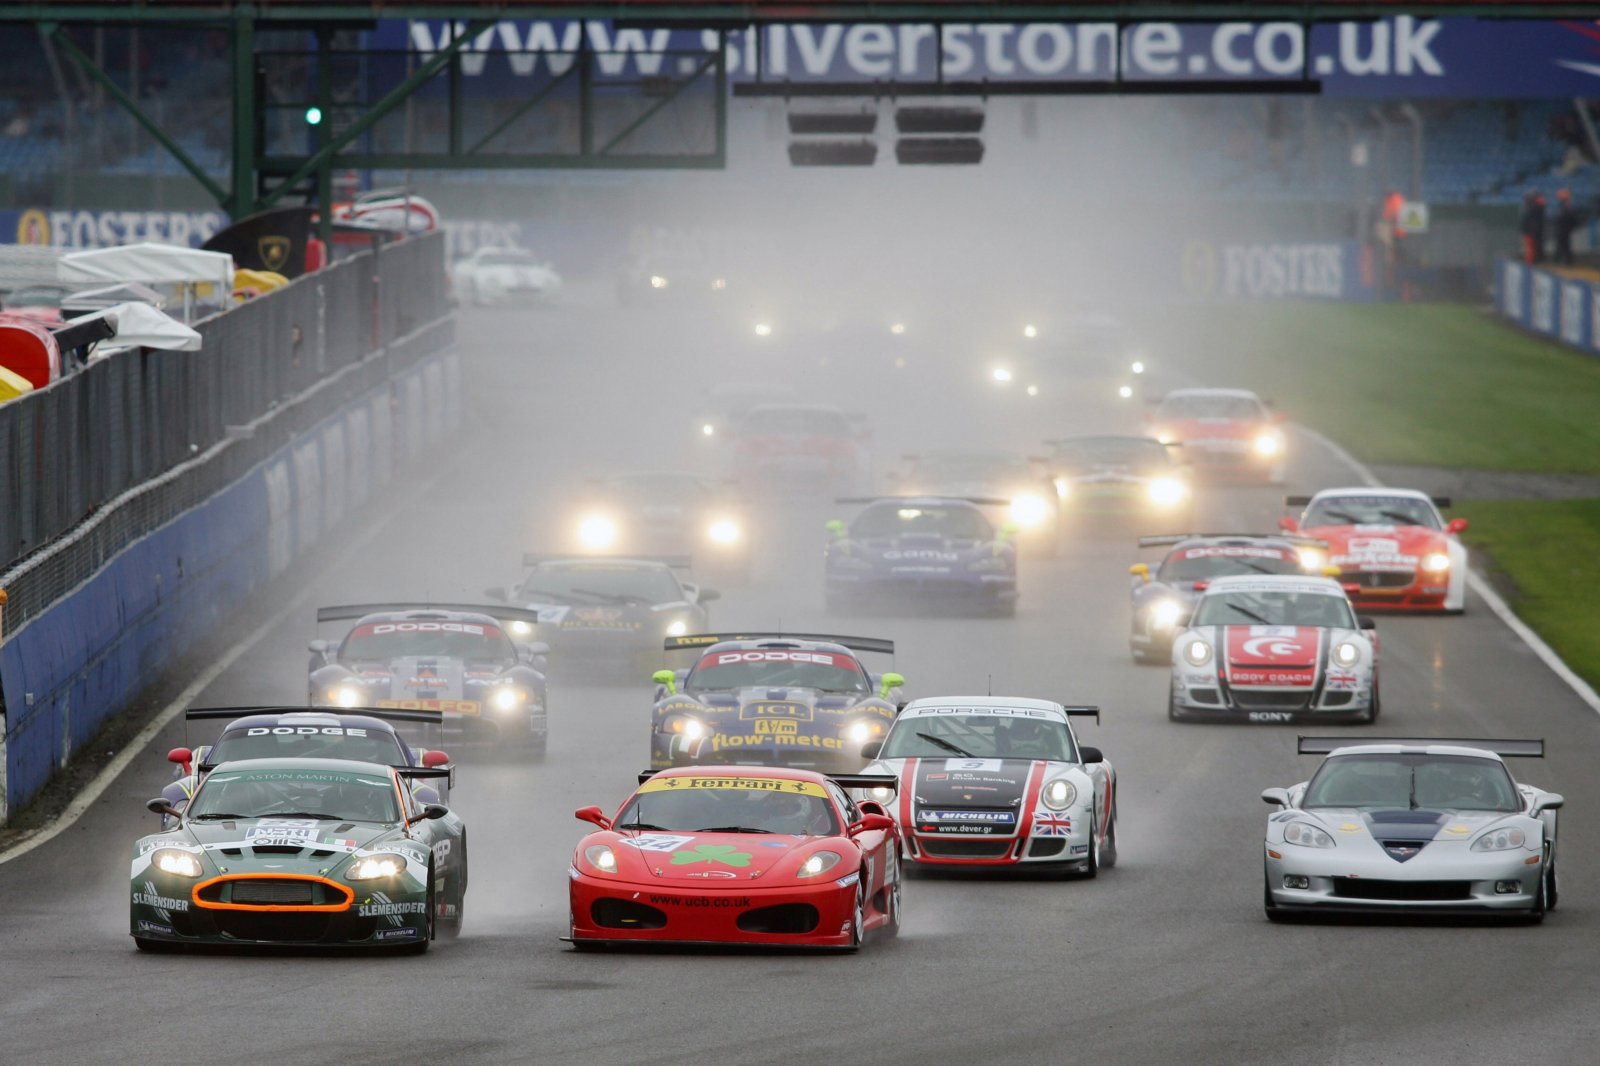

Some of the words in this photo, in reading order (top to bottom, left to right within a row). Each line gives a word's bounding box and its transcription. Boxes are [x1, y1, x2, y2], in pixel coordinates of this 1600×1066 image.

[1186, 547, 1282, 559] DODGE
[374, 623, 484, 635] DODGE
[718, 652, 833, 665] DODGE
[1269, 673, 1313, 682] COACH
[918, 708, 1046, 717] PORSCHE
[1249, 712, 1293, 722] SONY
[248, 727, 367, 737] DODGE
[712, 732, 845, 751] flow-meter
[247, 773, 293, 781] ASTON
[296, 774, 350, 783] MARTIN
[688, 777, 783, 791] Ferrari
[941, 812, 1009, 821] MICHELIN
[938, 825, 993, 835] www.dever.gr
[650, 894, 751, 908] www.ucb.co.uk
